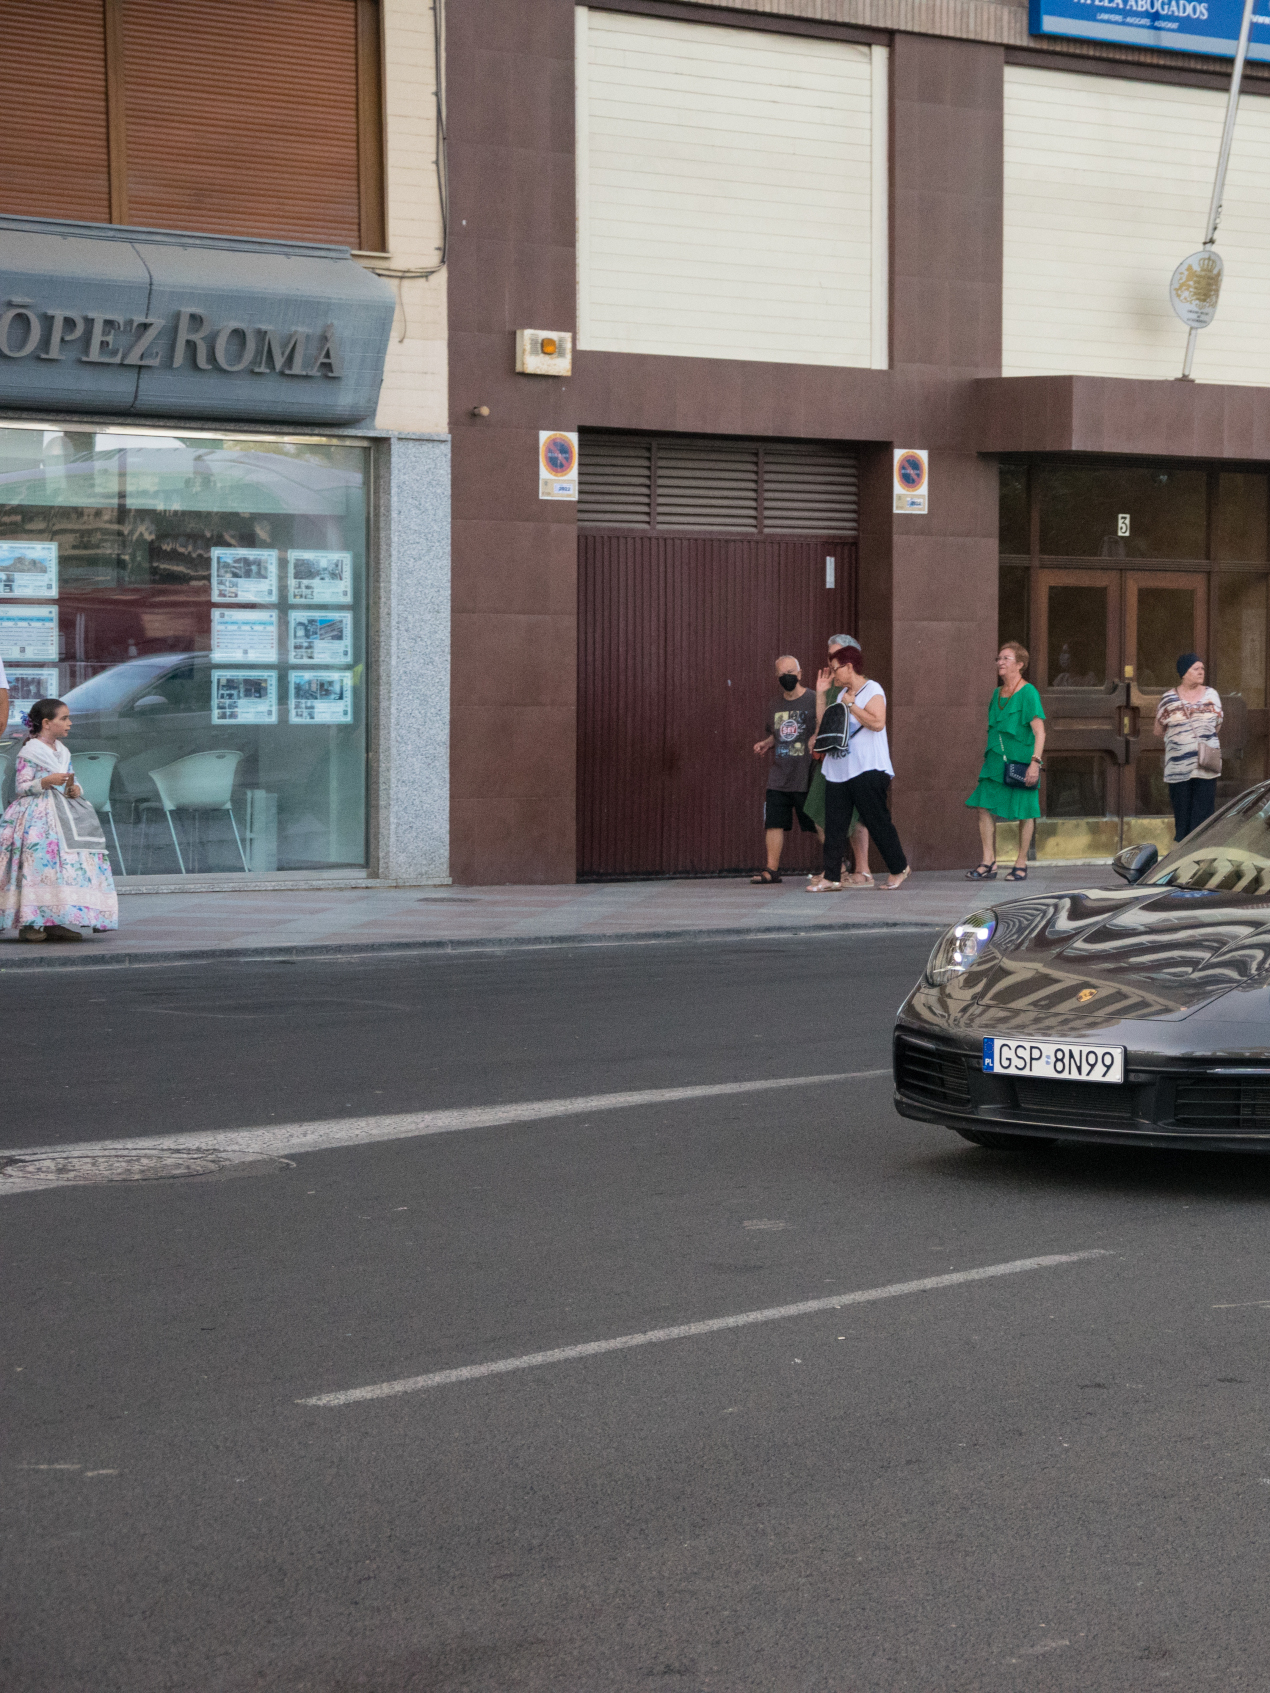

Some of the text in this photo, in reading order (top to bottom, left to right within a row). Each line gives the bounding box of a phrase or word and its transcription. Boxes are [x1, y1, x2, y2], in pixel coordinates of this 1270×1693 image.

[1126, 0, 1208, 20] ABOGADOS
[1119, 516, 1129, 534] 3
[984, 1058, 993, 1067] PL
[999, 1043, 1115, 1078] GSP 8N99
